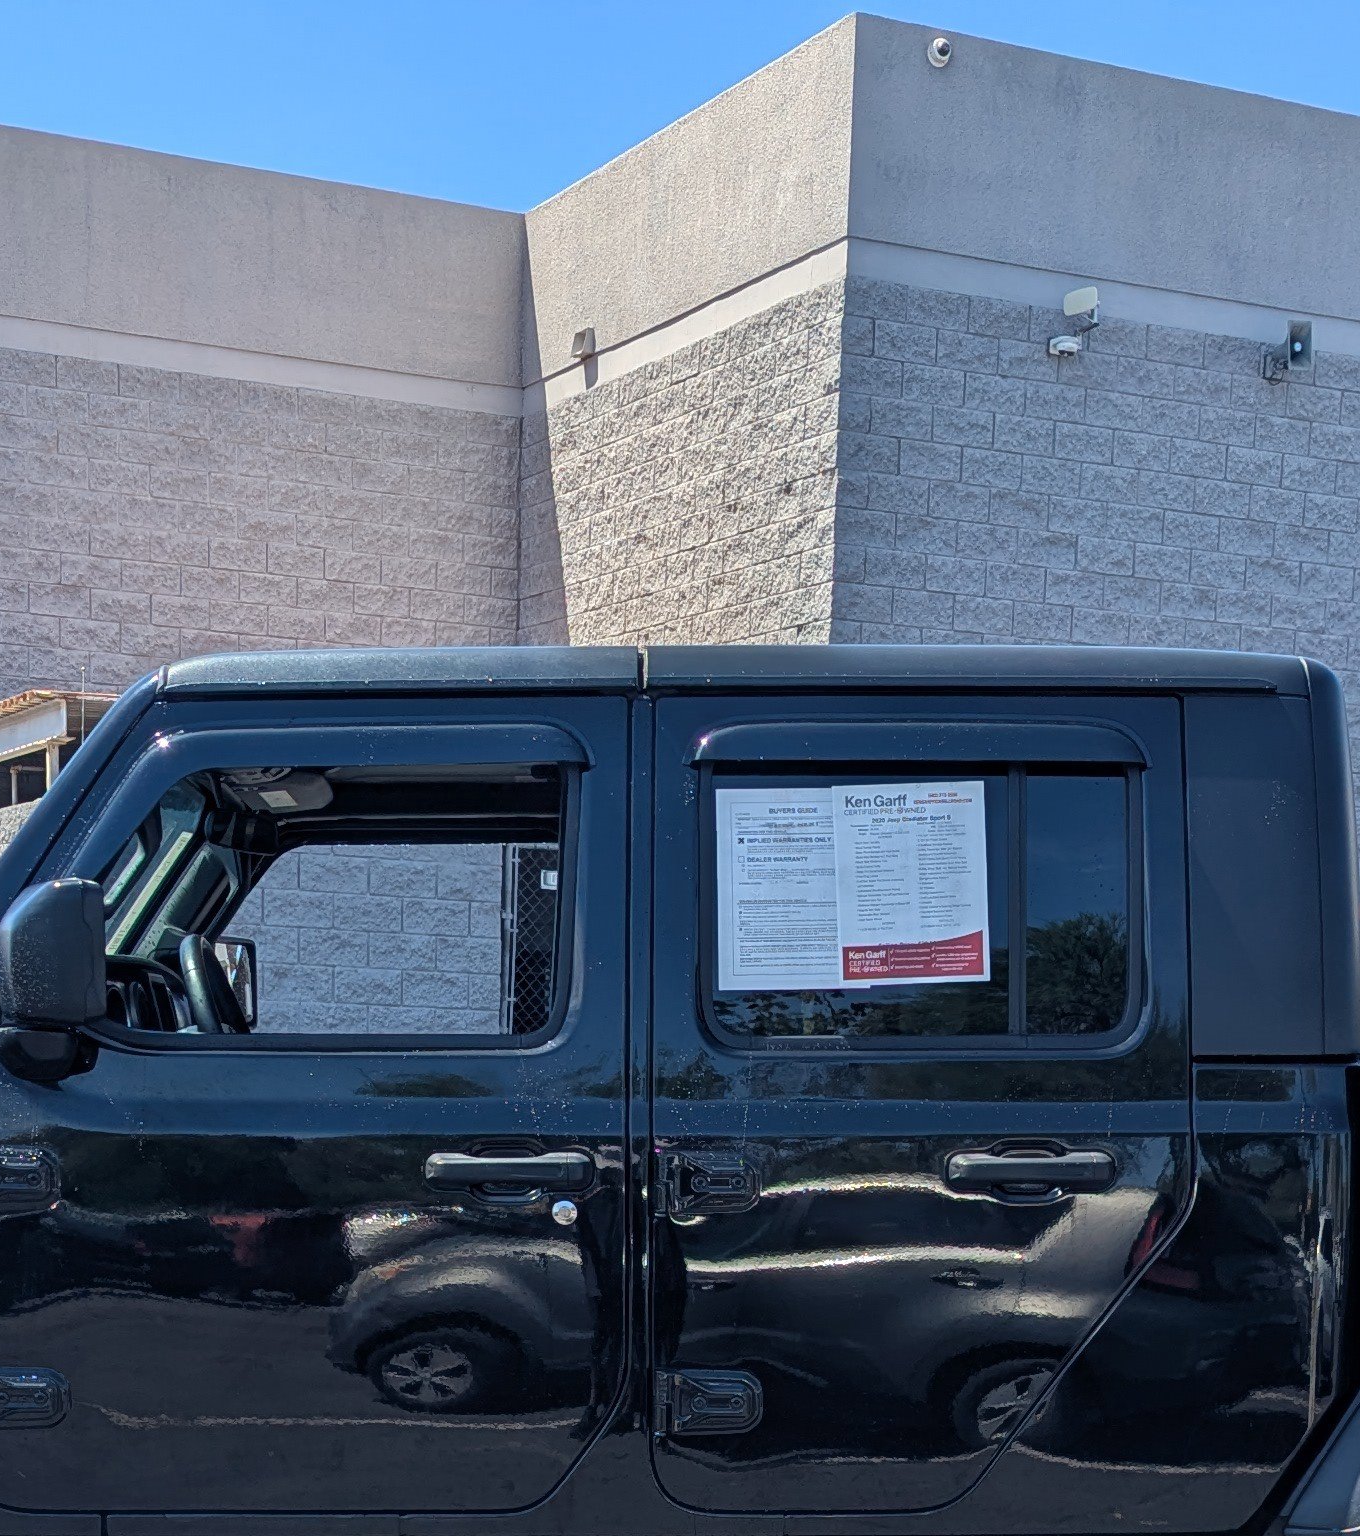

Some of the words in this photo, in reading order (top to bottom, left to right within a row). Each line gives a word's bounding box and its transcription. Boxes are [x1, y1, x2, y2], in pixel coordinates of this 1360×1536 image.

[845, 795, 871, 808] Ken
[874, 794, 907, 807] Garff
[848, 951, 865, 959] Ken
[866, 950, 887, 959] Garff
